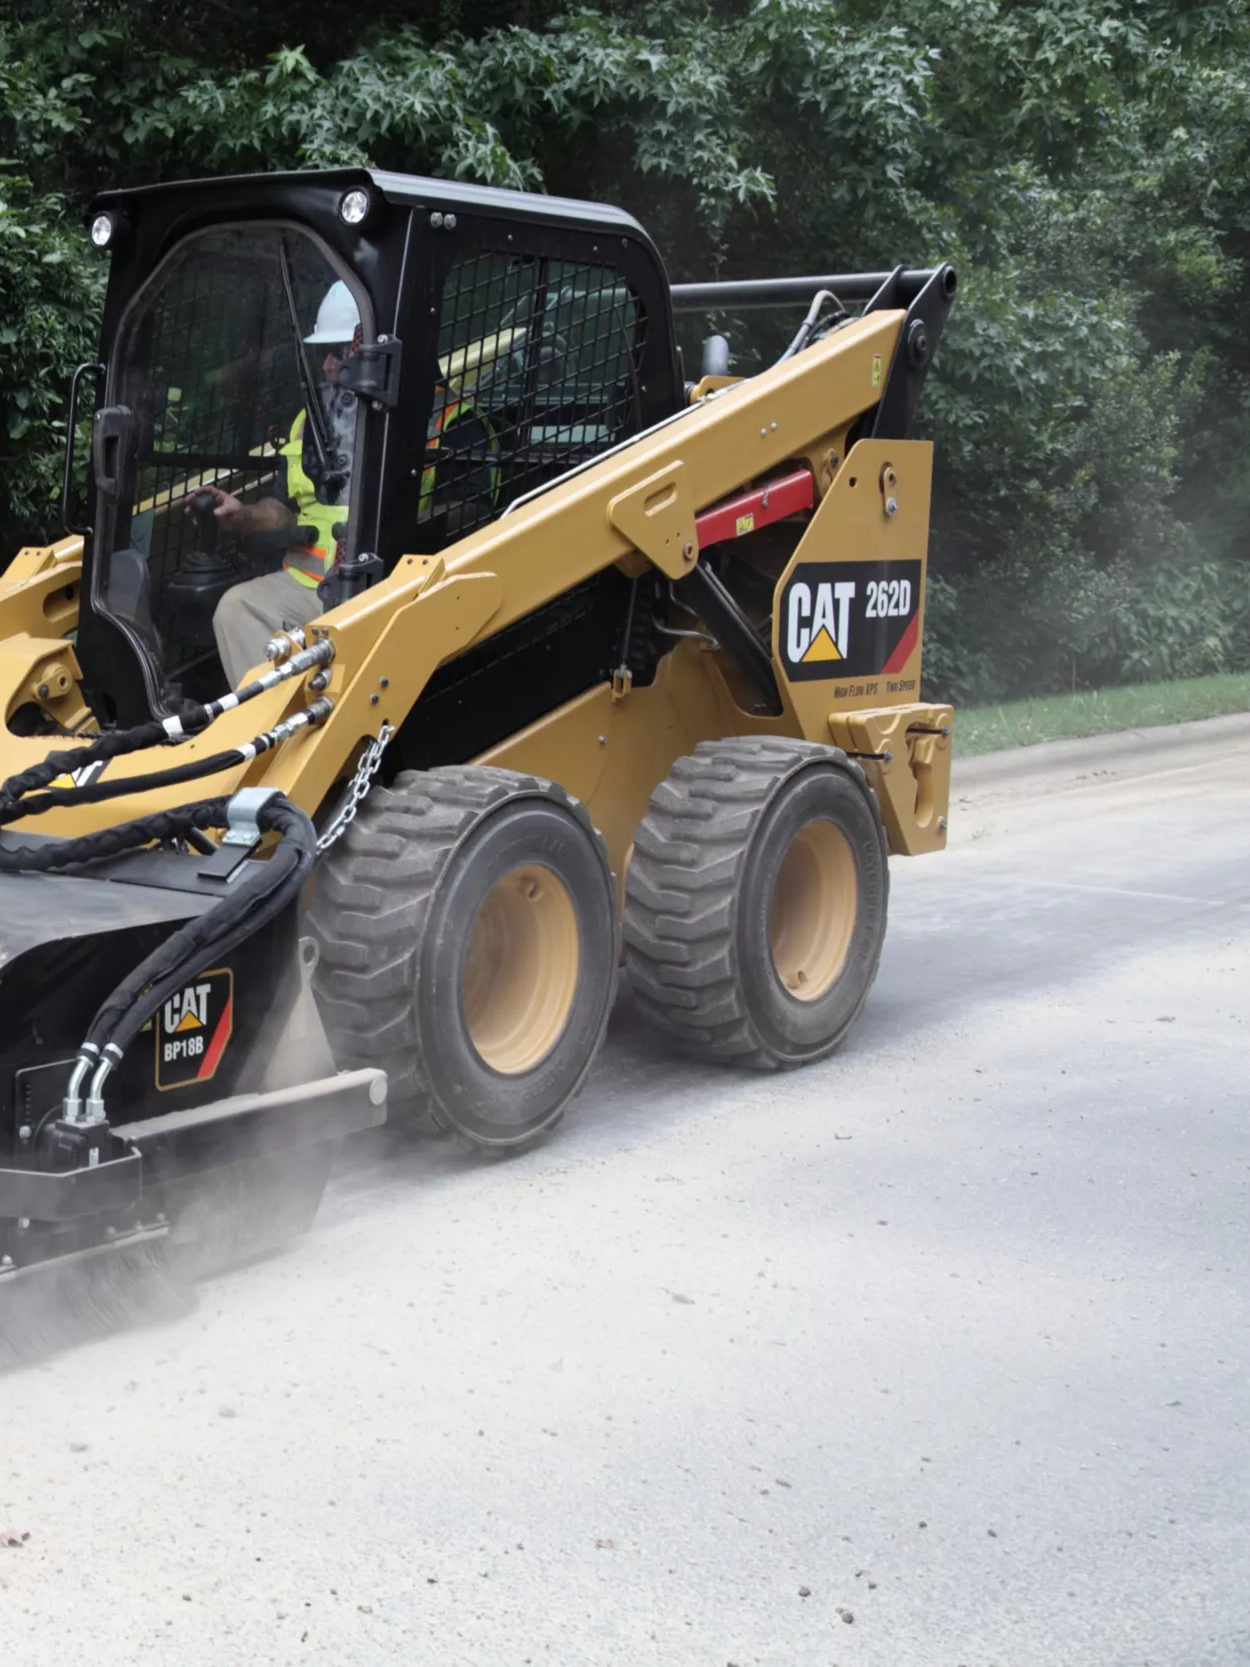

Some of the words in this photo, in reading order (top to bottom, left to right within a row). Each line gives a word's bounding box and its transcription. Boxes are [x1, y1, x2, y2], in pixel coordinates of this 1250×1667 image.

[787, 581, 855, 663] CAT
[865, 579, 911, 618] 262D
[865, 682, 879, 696] XPS
[164, 983, 211, 1034] CAT
[164, 1035, 204, 1062] BP18B
